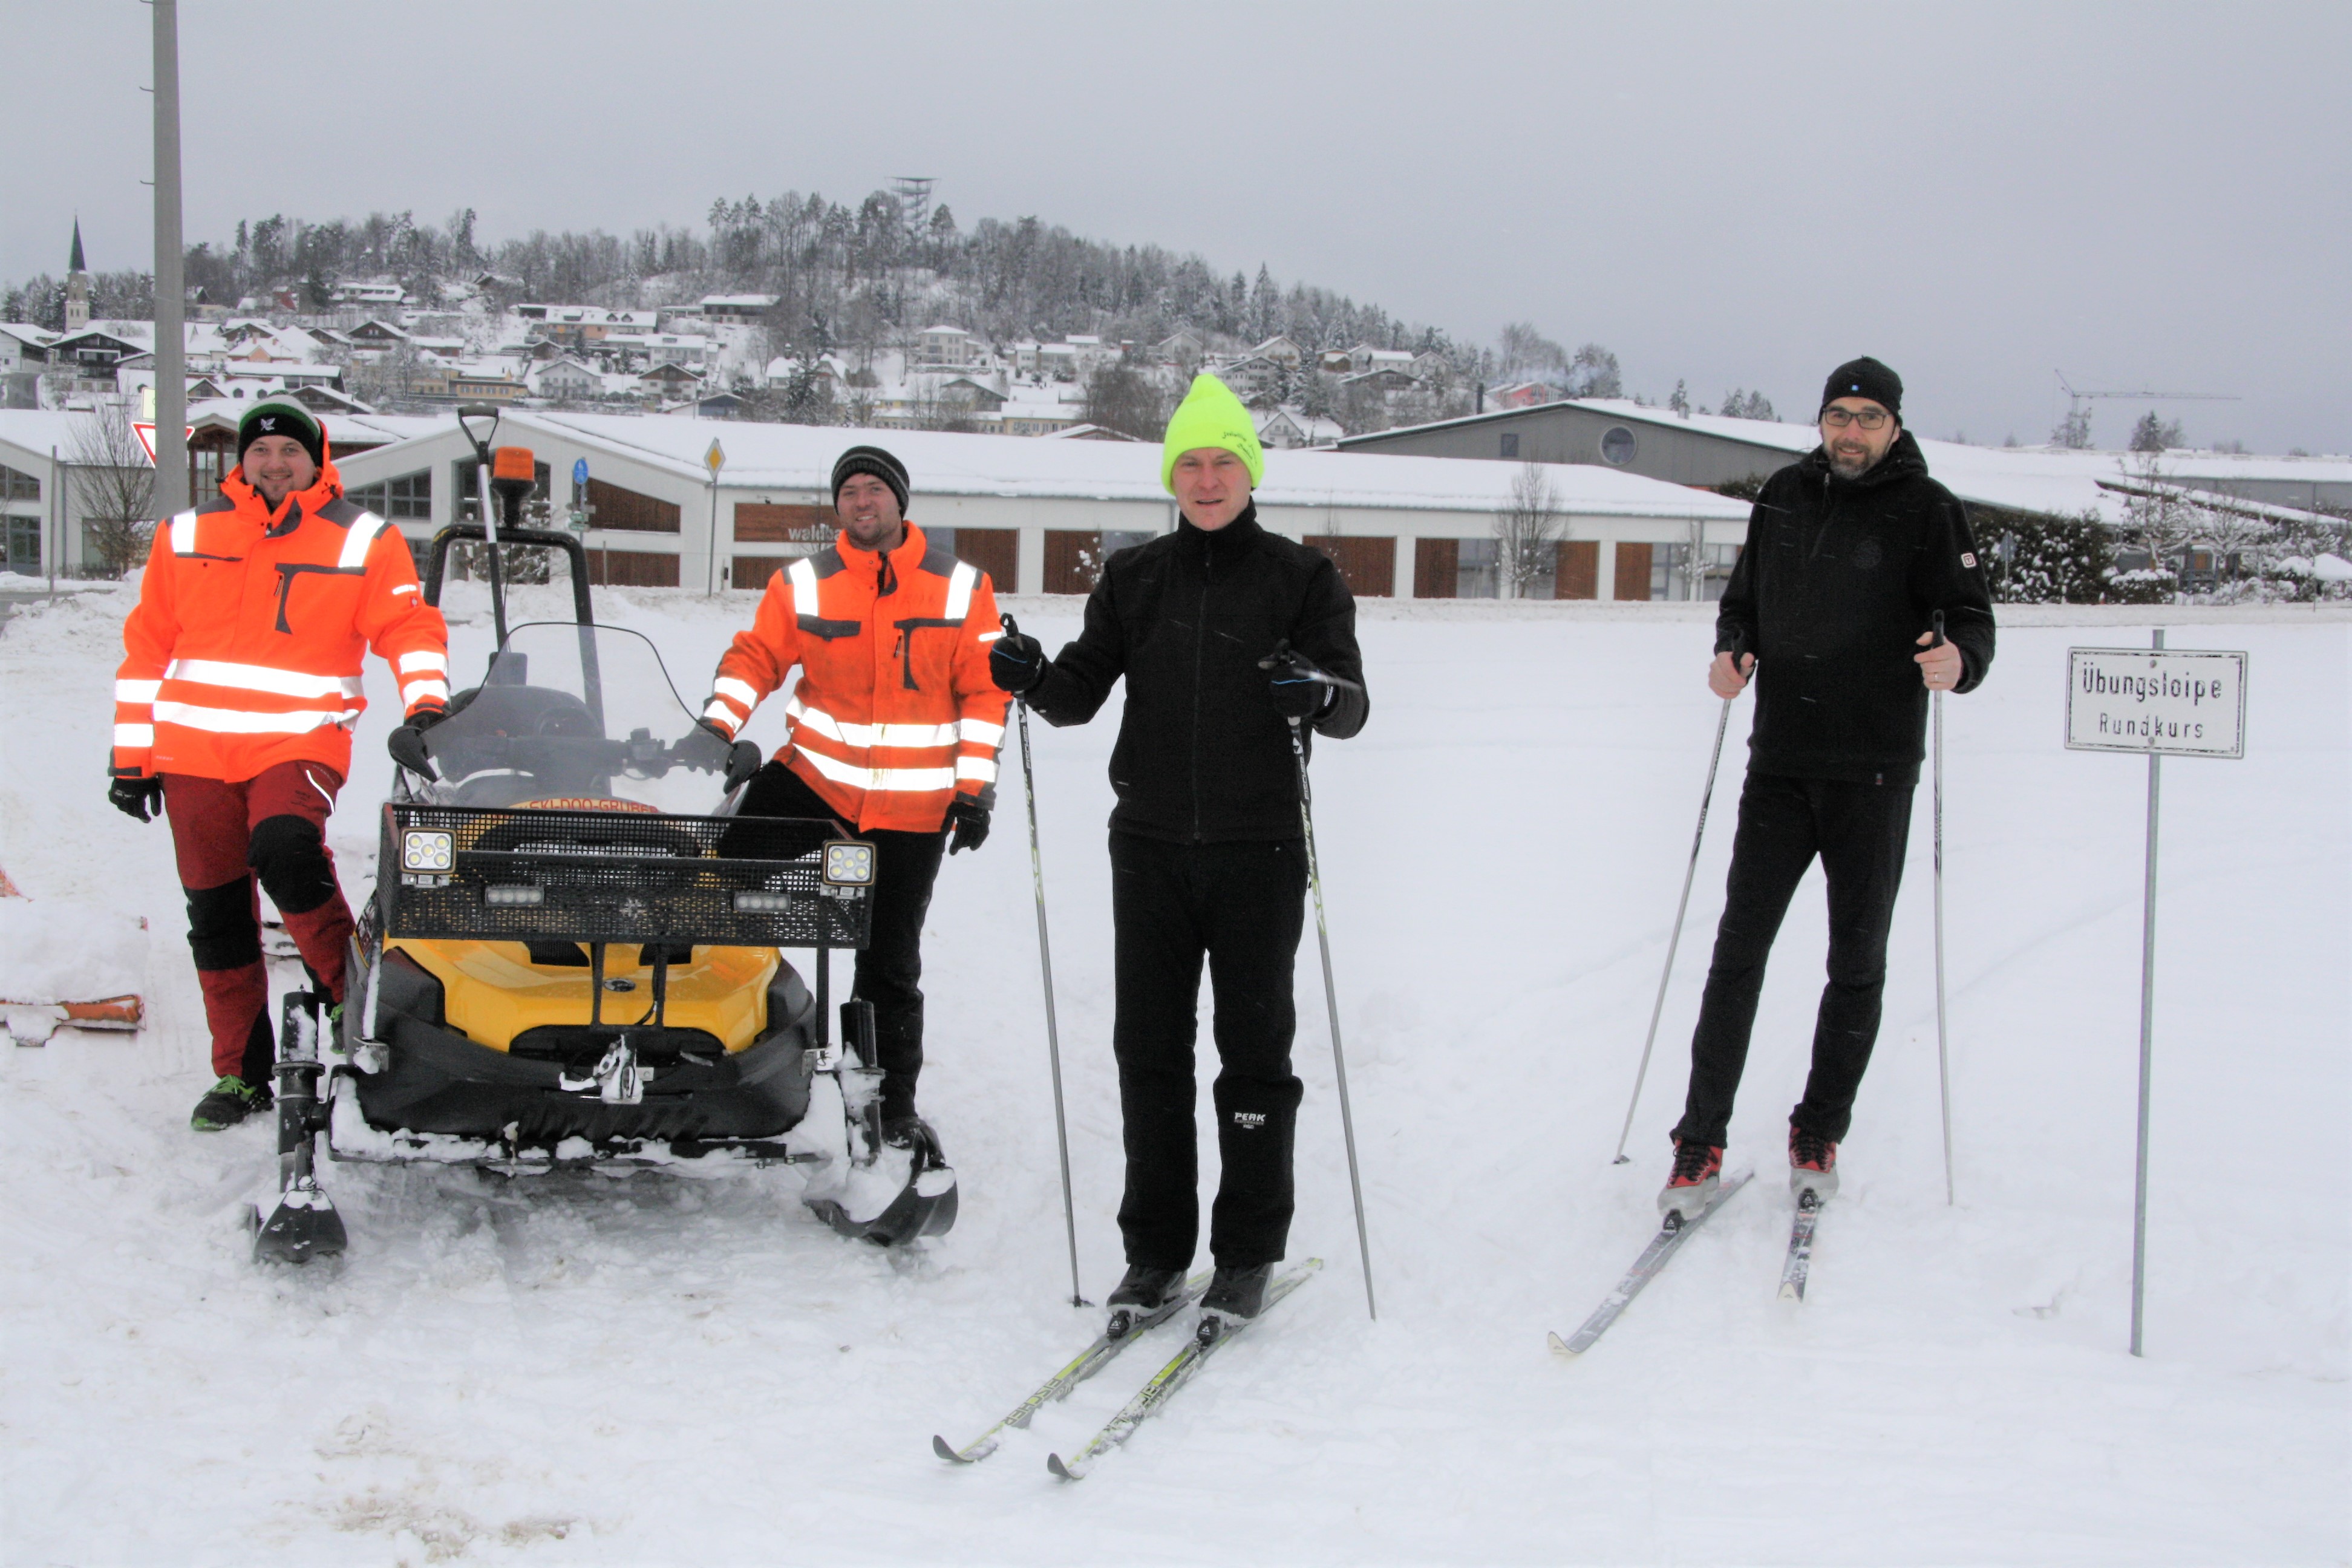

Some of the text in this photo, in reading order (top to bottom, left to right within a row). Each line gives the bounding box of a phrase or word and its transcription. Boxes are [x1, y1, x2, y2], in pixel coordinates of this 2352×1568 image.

[2083, 662, 2222, 707] Übungsloipe
[1023, 726, 1031, 769] FISCHER
[2099, 712, 2204, 739] Rundkurs
[1300, 756, 1310, 800] FISCHER
[1005, 1377, 1063, 1425] FISCHER
